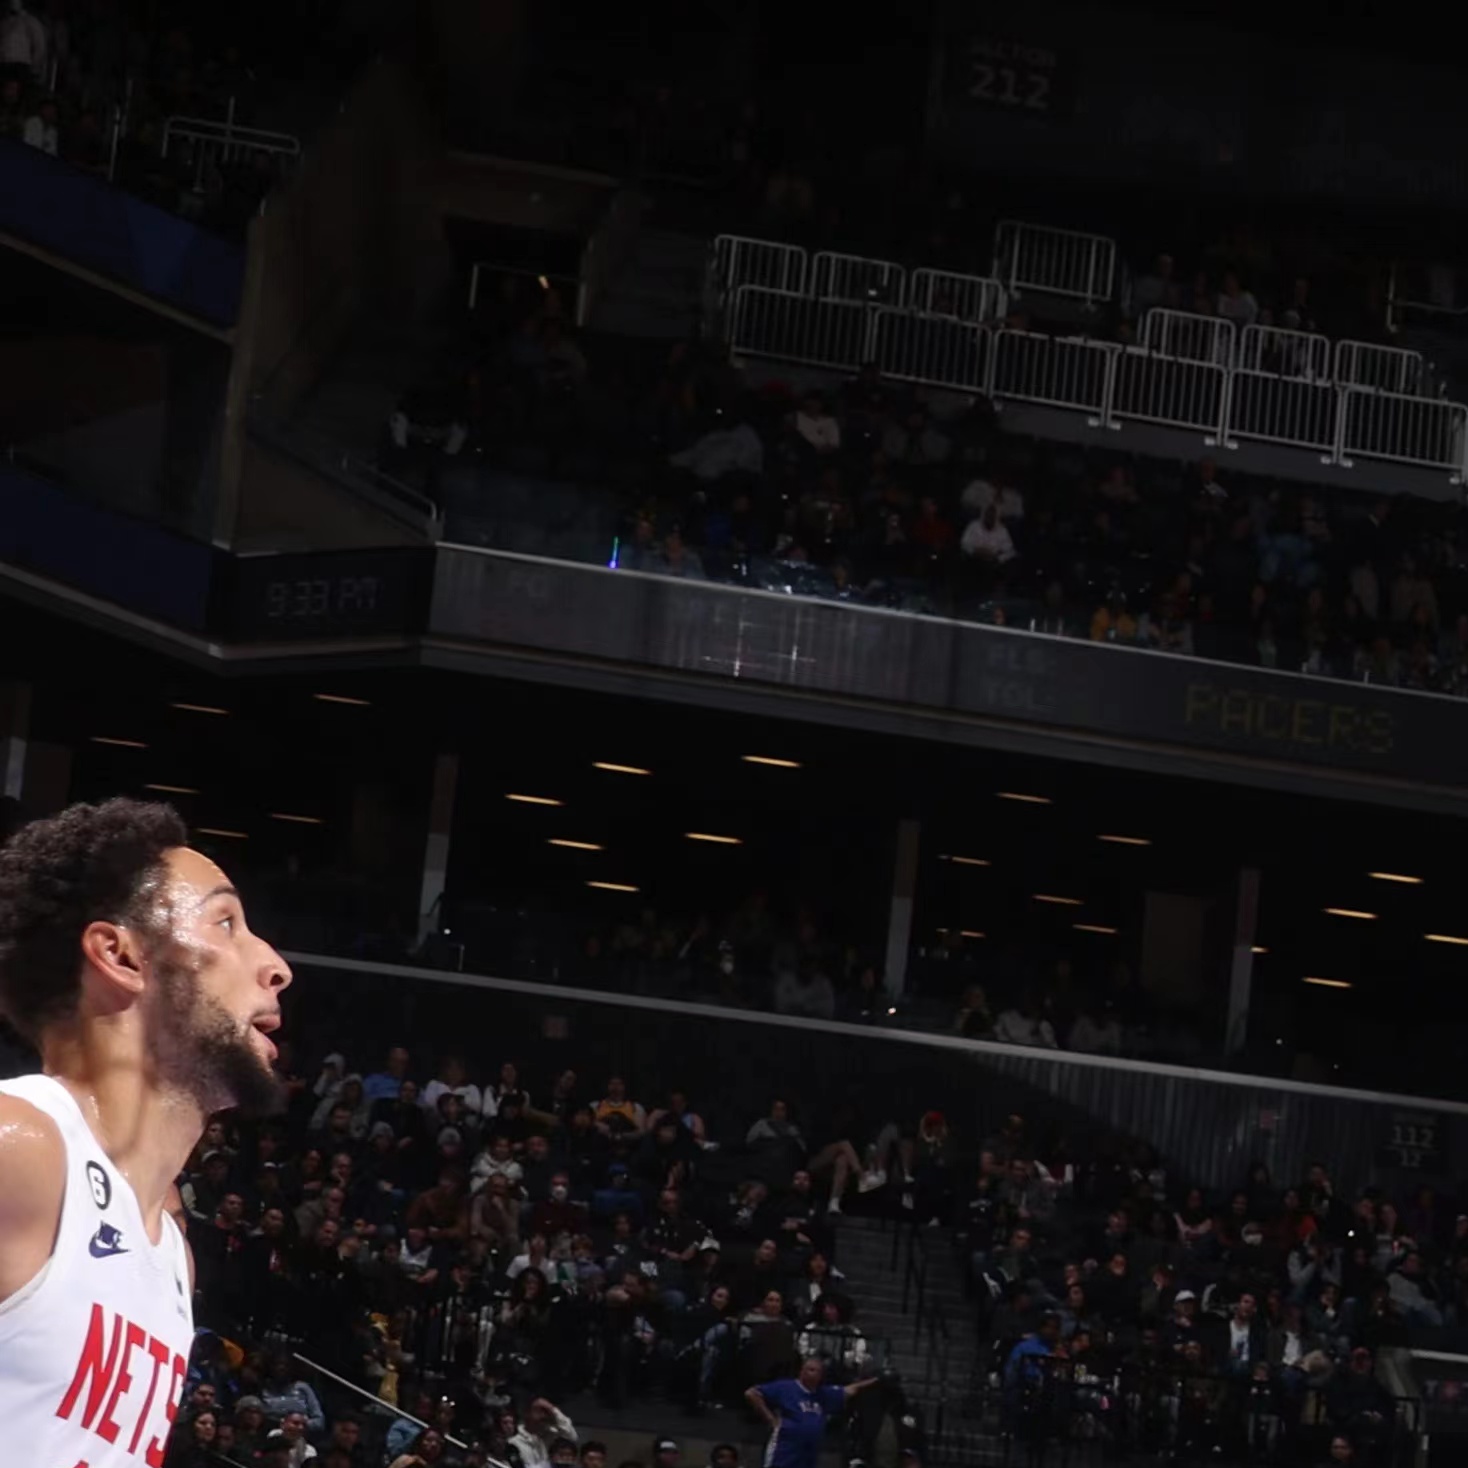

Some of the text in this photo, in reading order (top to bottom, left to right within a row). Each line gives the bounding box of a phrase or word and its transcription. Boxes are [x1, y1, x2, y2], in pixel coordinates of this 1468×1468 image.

[968, 63, 1050, 110] 212
[1185, 684, 1394, 753] PACERS
[1392, 1125, 1434, 1149] 112
